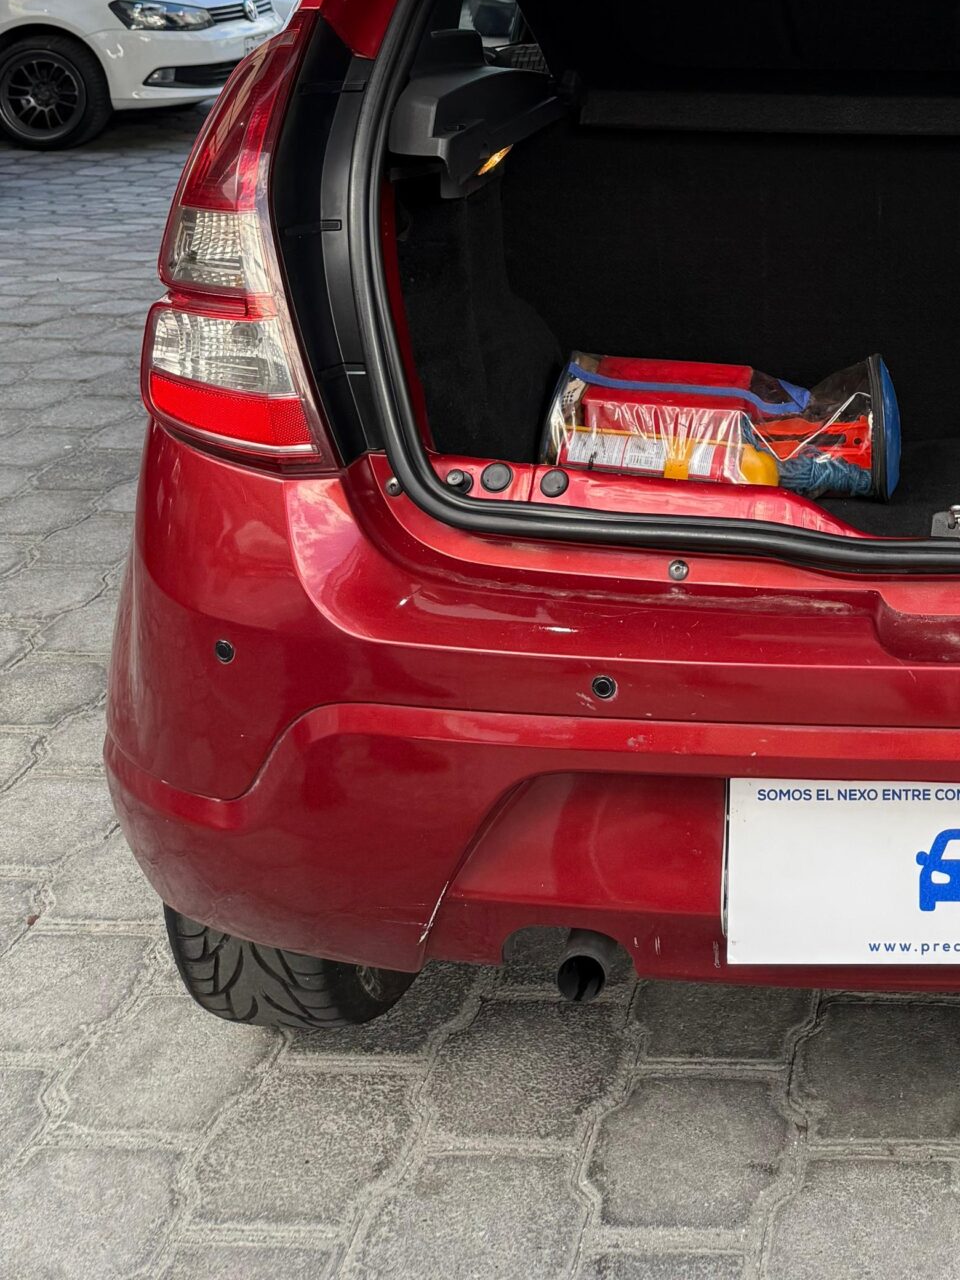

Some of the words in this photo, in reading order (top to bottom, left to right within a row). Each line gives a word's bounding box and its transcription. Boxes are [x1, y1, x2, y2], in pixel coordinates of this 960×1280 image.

[757, 788, 812, 801] SOMOS
[816, 788, 834, 801] EL
[837, 788, 878, 801] NEXO
[882, 788, 931, 801] ENTRE
